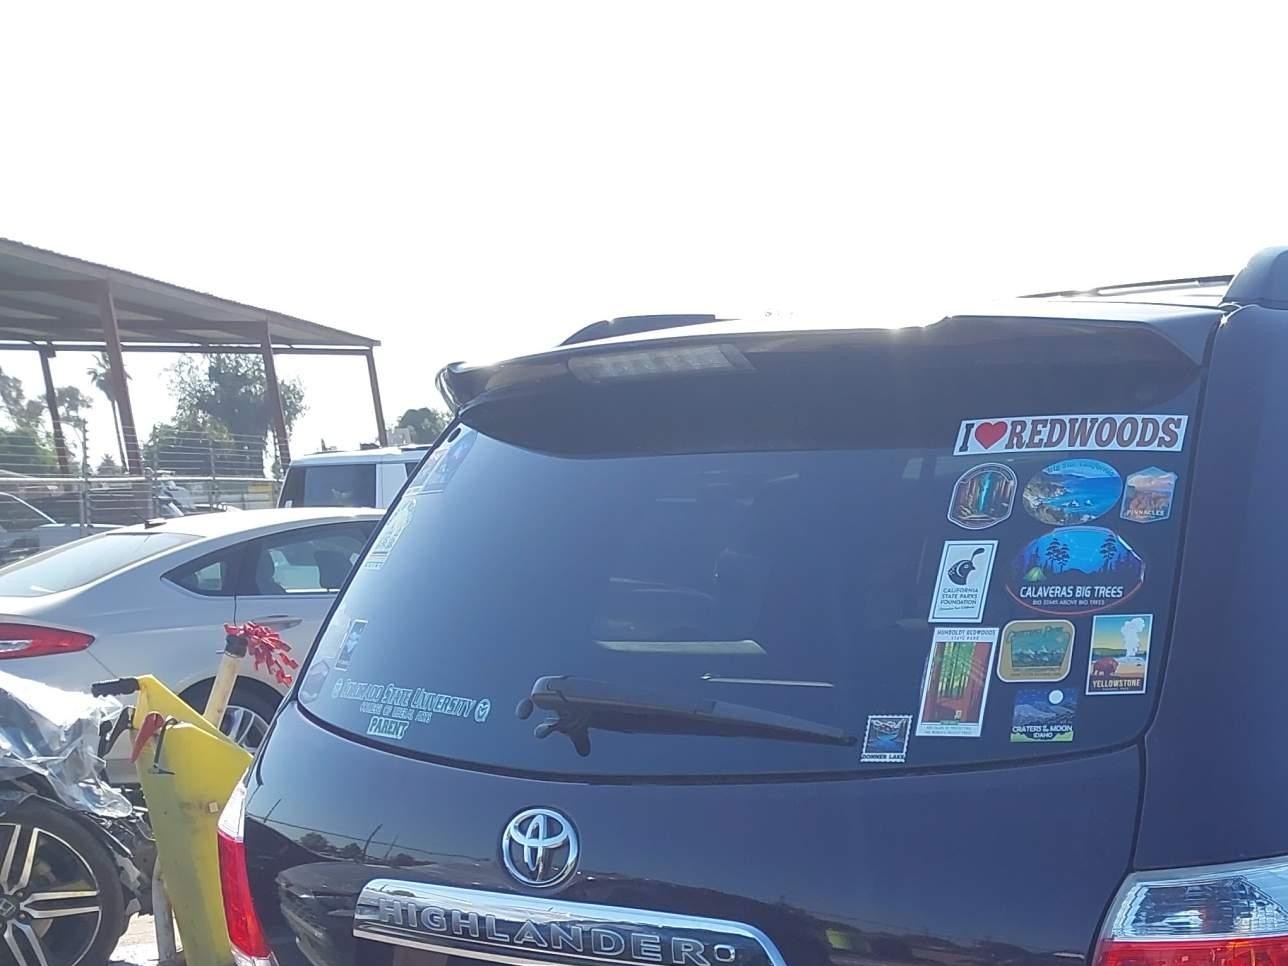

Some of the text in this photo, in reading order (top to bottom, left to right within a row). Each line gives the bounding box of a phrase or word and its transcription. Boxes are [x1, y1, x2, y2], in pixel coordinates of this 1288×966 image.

[959, 417, 1182, 451] I REDWOODS
[1020, 586, 1124, 598] CALAVERAS BIG TREES
[1092, 679, 1141, 688] YELLOWSTONE
[411, 688, 476, 717] UNIVERSITY
[367, 715, 409, 739] PARENT
[1012, 725, 1042, 733] CRATERS
[1050, 724, 1073, 732] MOON
